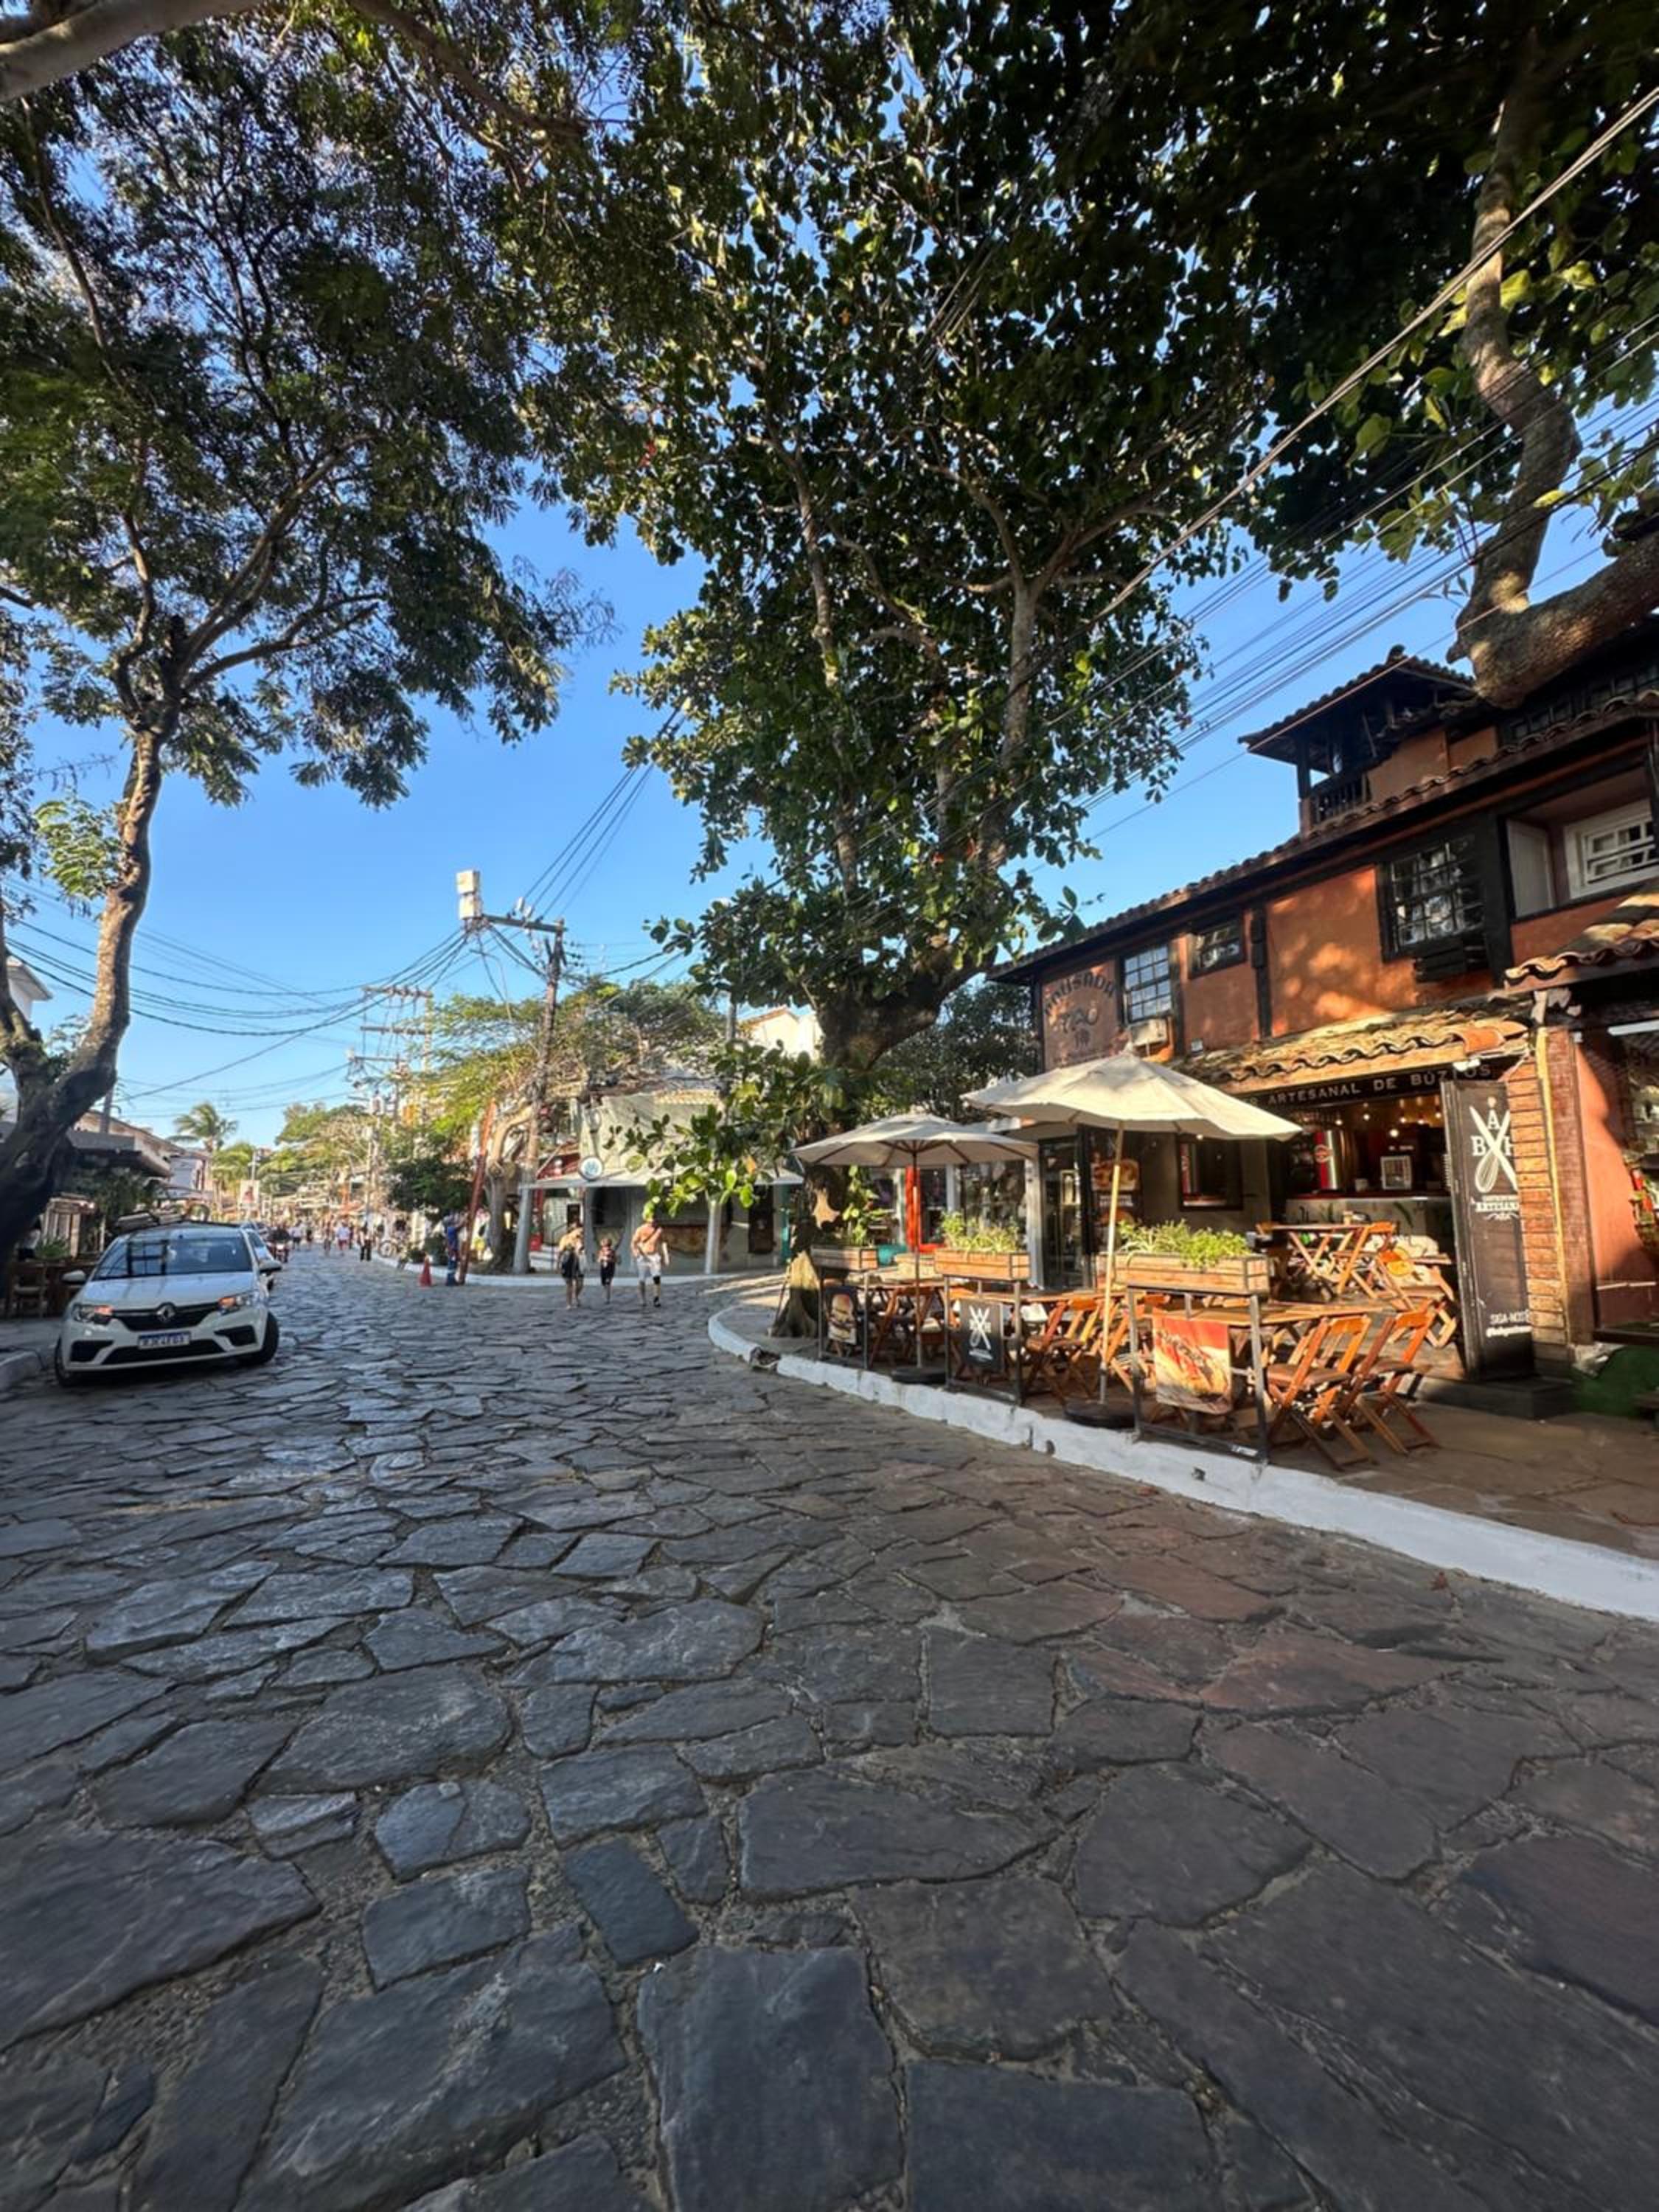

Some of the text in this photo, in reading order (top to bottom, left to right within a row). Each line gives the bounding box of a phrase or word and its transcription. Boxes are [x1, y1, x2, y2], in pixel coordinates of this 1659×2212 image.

[1267, 1082, 1362, 1105] ARTESANAL
[1373, 1077, 1397, 1091] DE
[1410, 1064, 1492, 1086] BÚZIOS
